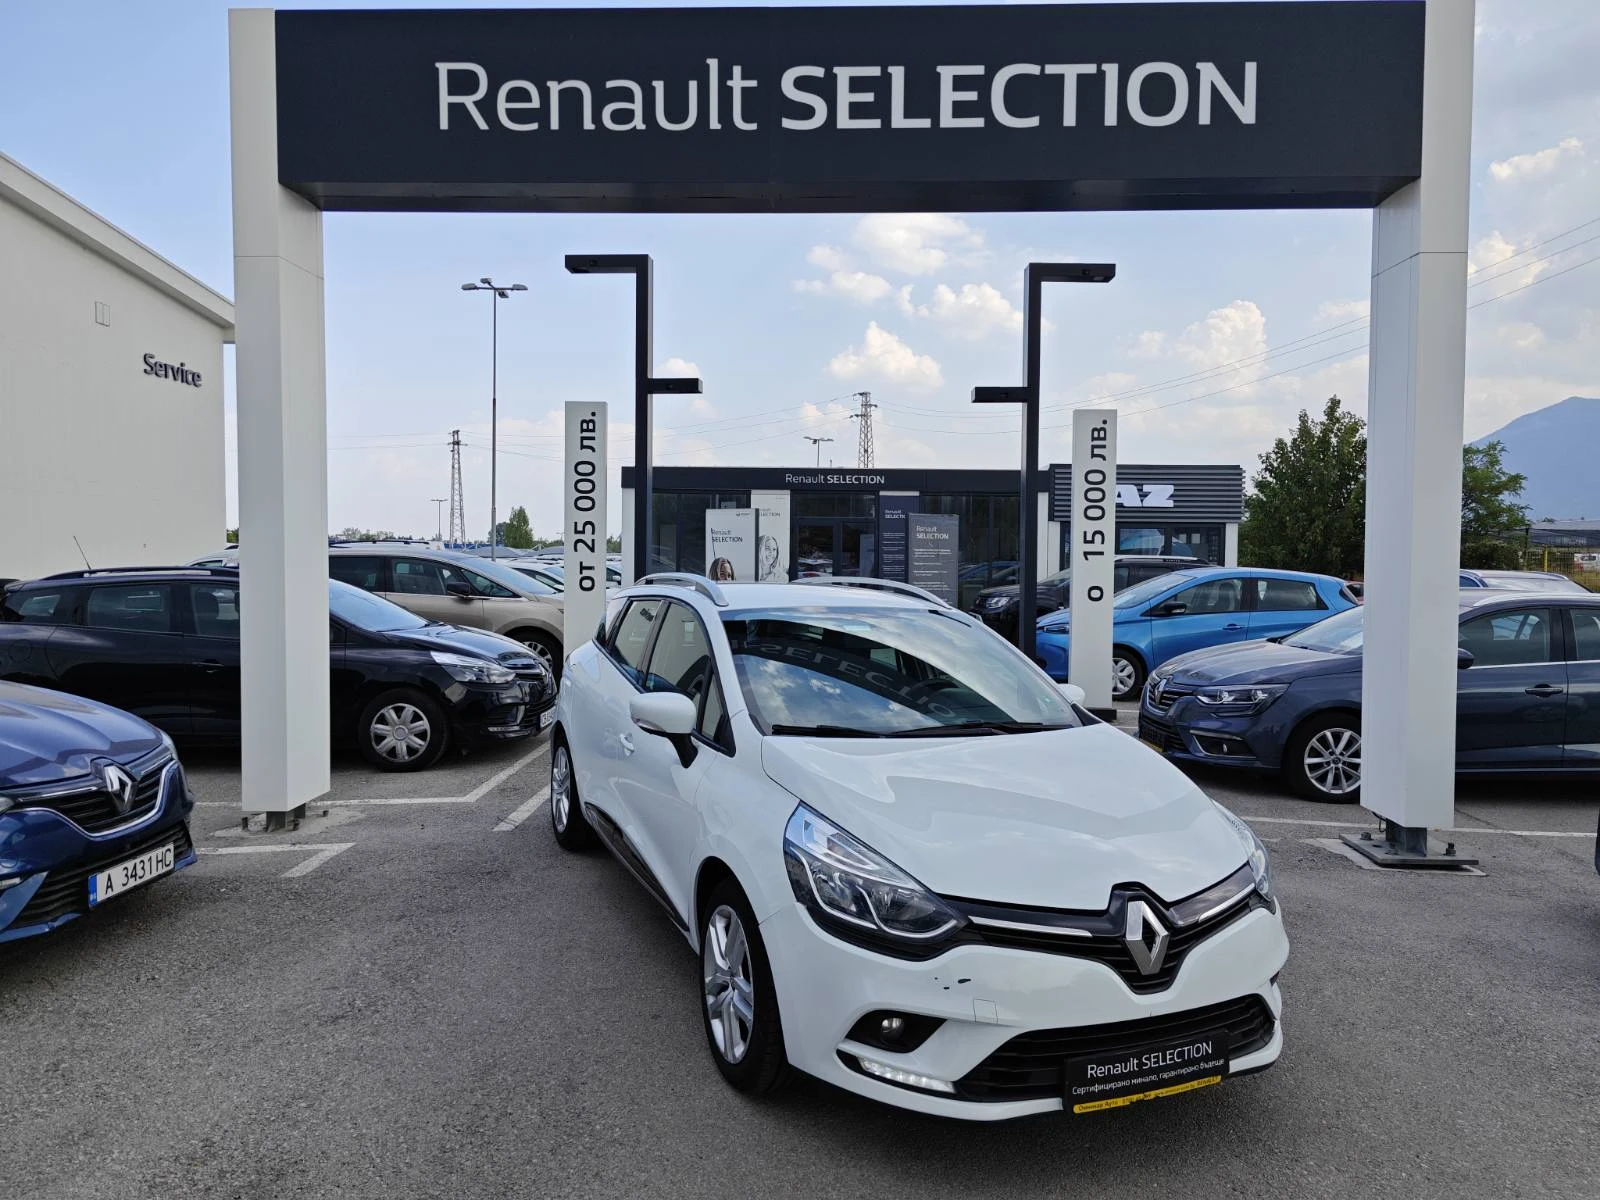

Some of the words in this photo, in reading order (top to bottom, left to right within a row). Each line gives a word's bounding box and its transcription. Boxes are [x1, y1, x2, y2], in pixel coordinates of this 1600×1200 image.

[434, 58, 758, 132] Renault
[779, 60, 1258, 131] SELECTION
[143, 353, 202, 388] Service
[580, 410, 597, 453] лв.
[1090, 419, 1108, 462] лв.
[573, 460, 596, 512] 000
[785, 473, 825, 484] Renault
[826, 474, 885, 485] SELECTION
[1083, 469, 1106, 521] 000
[573, 520, 596, 553] 25
[711, 536, 744, 544] SELECTION
[1083, 529, 1105, 561] 15
[578, 560, 596, 592] от
[1087, 1057, 1139, 1079] Renault
[1142, 1041, 1212, 1069] SELECTION
